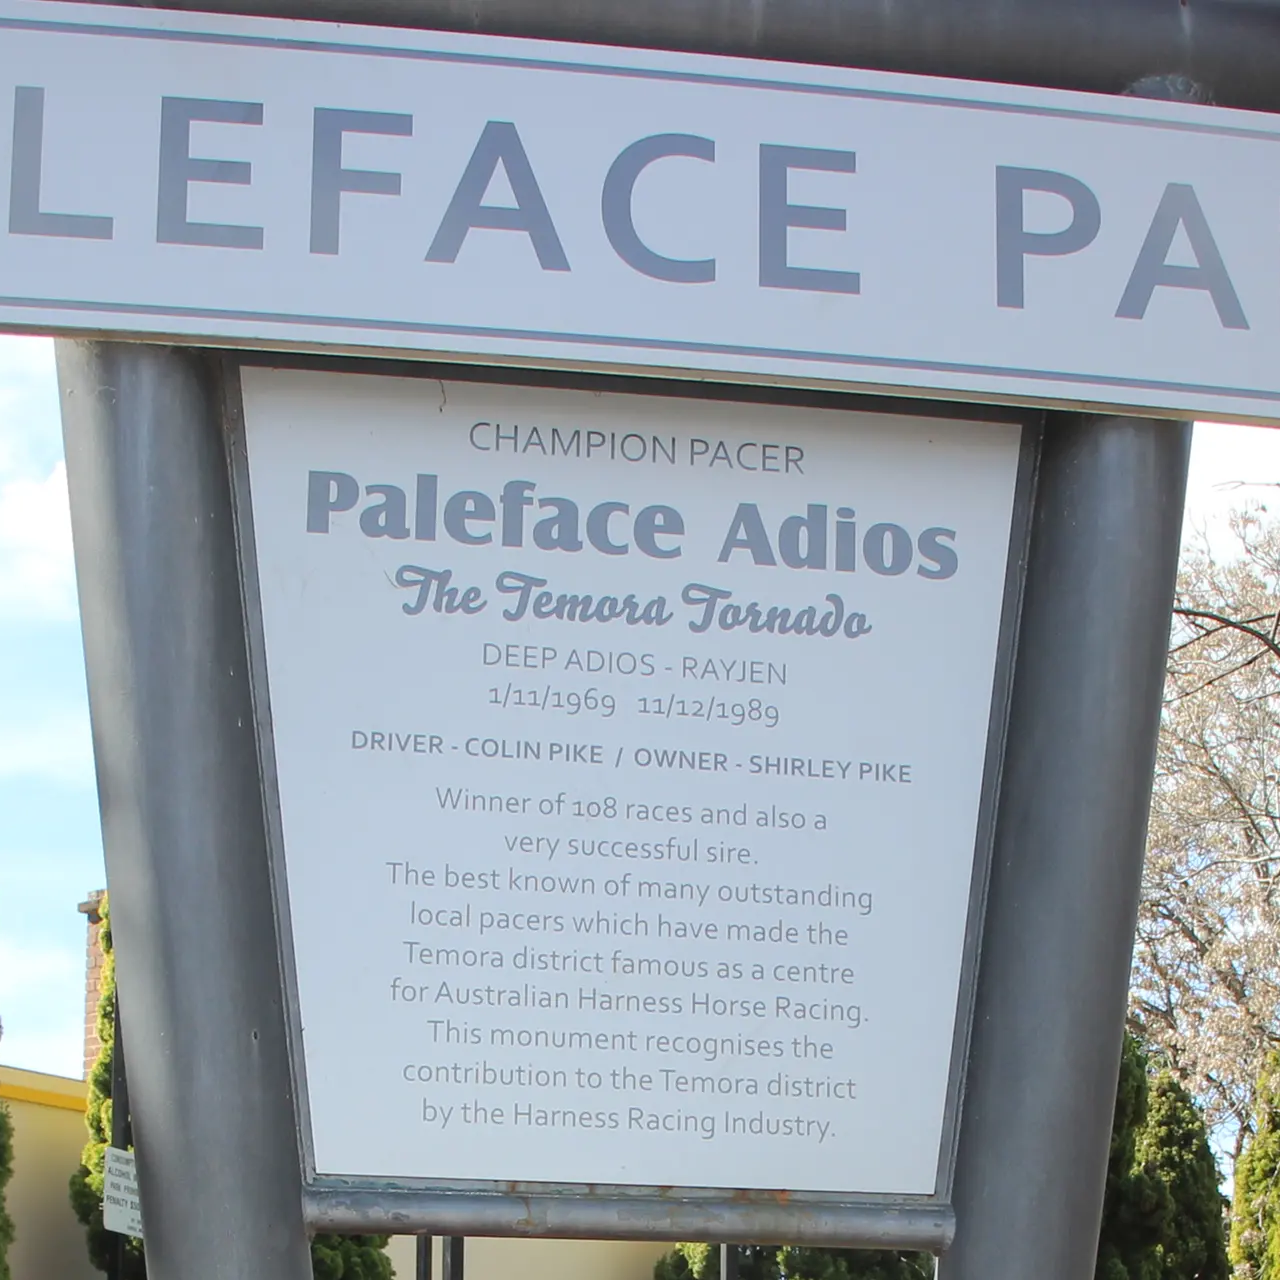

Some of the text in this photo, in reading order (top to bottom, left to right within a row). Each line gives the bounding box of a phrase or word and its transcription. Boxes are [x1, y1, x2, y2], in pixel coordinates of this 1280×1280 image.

[470, 422, 804, 474] CHAMPION PACER
[306, 470, 958, 580] Paleface Adios
[395, 565, 872, 639] The Temora Tornado
[483, 643, 557, 669] DEEP
[564, 649, 655, 676] ADIOS
[683, 656, 786, 685] RAYJEN
[489, 682, 779, 728] 1/11/1969 11/12/1989
[352, 730, 443, 754] DRIVER
[465, 738, 540, 760] COLIN
[549, 743, 603, 764] PIKE
[634, 748, 728, 772] OWNER
[749, 755, 852, 779] SHIRLEY
[859, 762, 911, 783] PIKE
[436, 787, 826, 830] Winner of 108 races and also a
[505, 835, 758, 865] very successful sire.
[386, 861, 872, 915] The best known of many outstanding
[411, 900, 848, 945] local pacers which have made the
[403, 941, 854, 984] Temora district famous as a centre
[390, 977, 868, 1029] for Australian Harness Horse Racing.
[427, 1019, 833, 1061] This monument recognises the
[403, 1060, 856, 1099] contribution to the Temora district
[423, 1097, 835, 1143] by the Harness Racing Industry.
[108, 1166, 131, 1181] ALCOHOL
[106, 1194, 128, 1209] PENALTY
